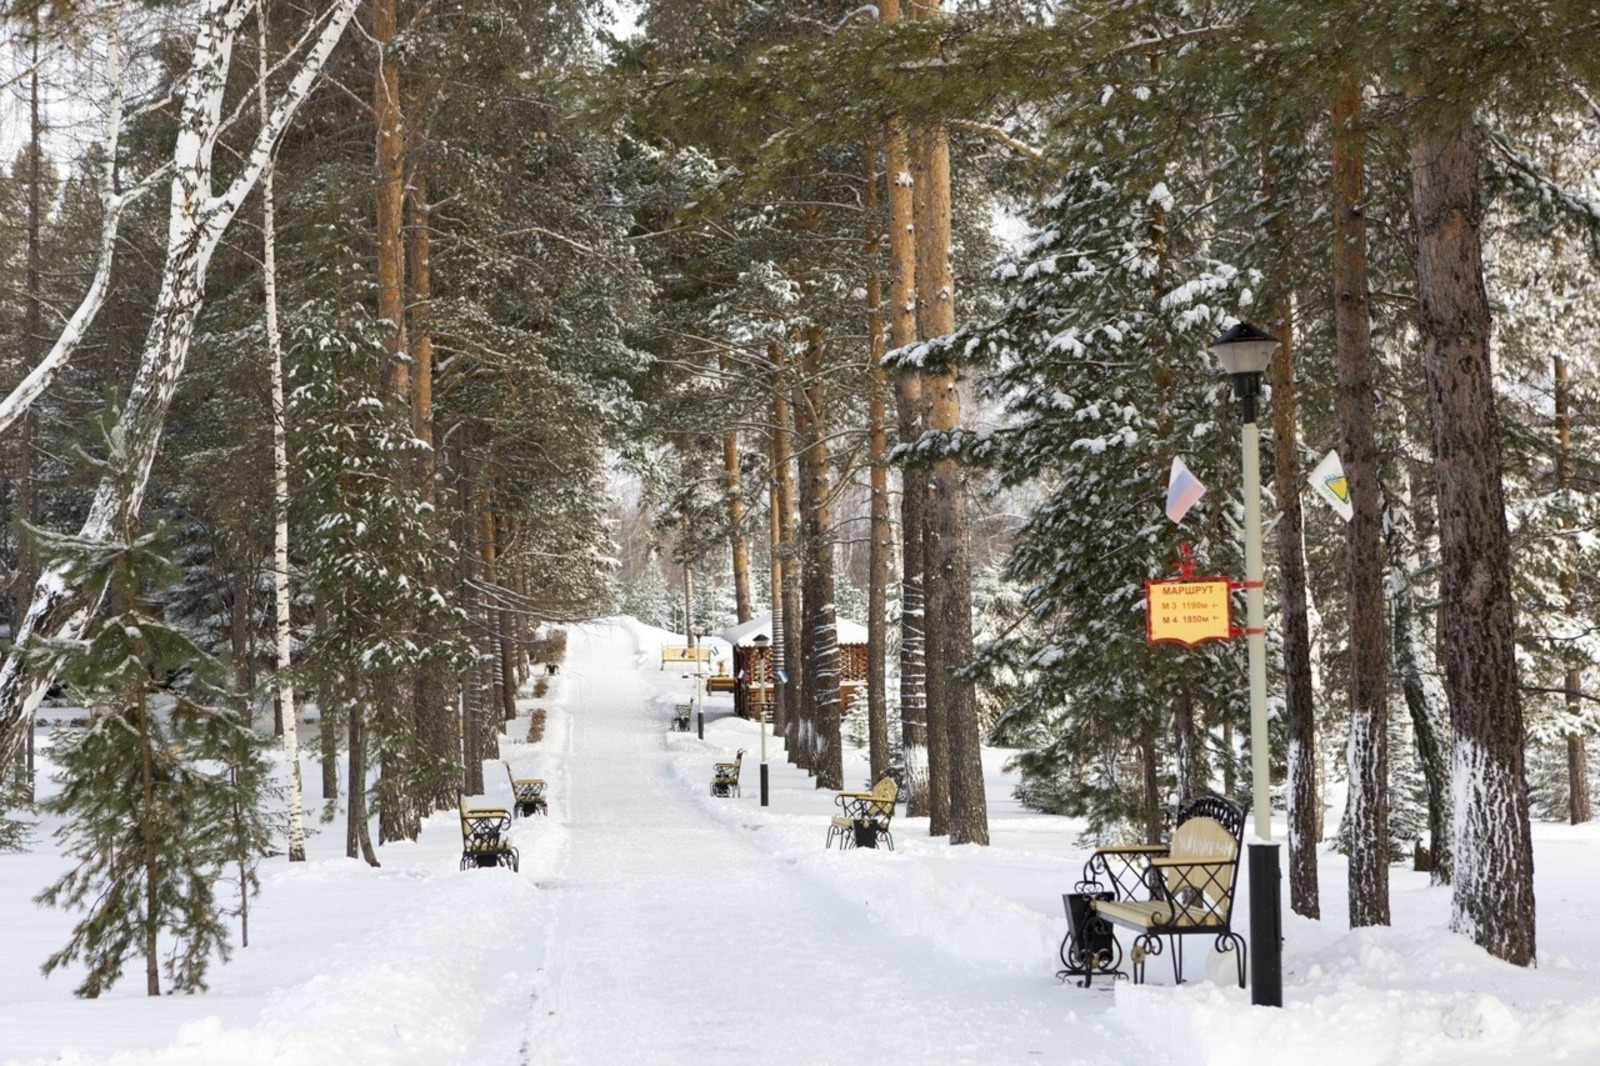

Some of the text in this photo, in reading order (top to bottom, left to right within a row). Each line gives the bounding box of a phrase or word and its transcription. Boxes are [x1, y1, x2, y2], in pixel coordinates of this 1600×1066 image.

[1162, 586, 1214, 595] МАРШРУТ
[1162, 602, 1208, 610] М 3 1190м
[1162, 615, 1209, 624] М 4 1850м
